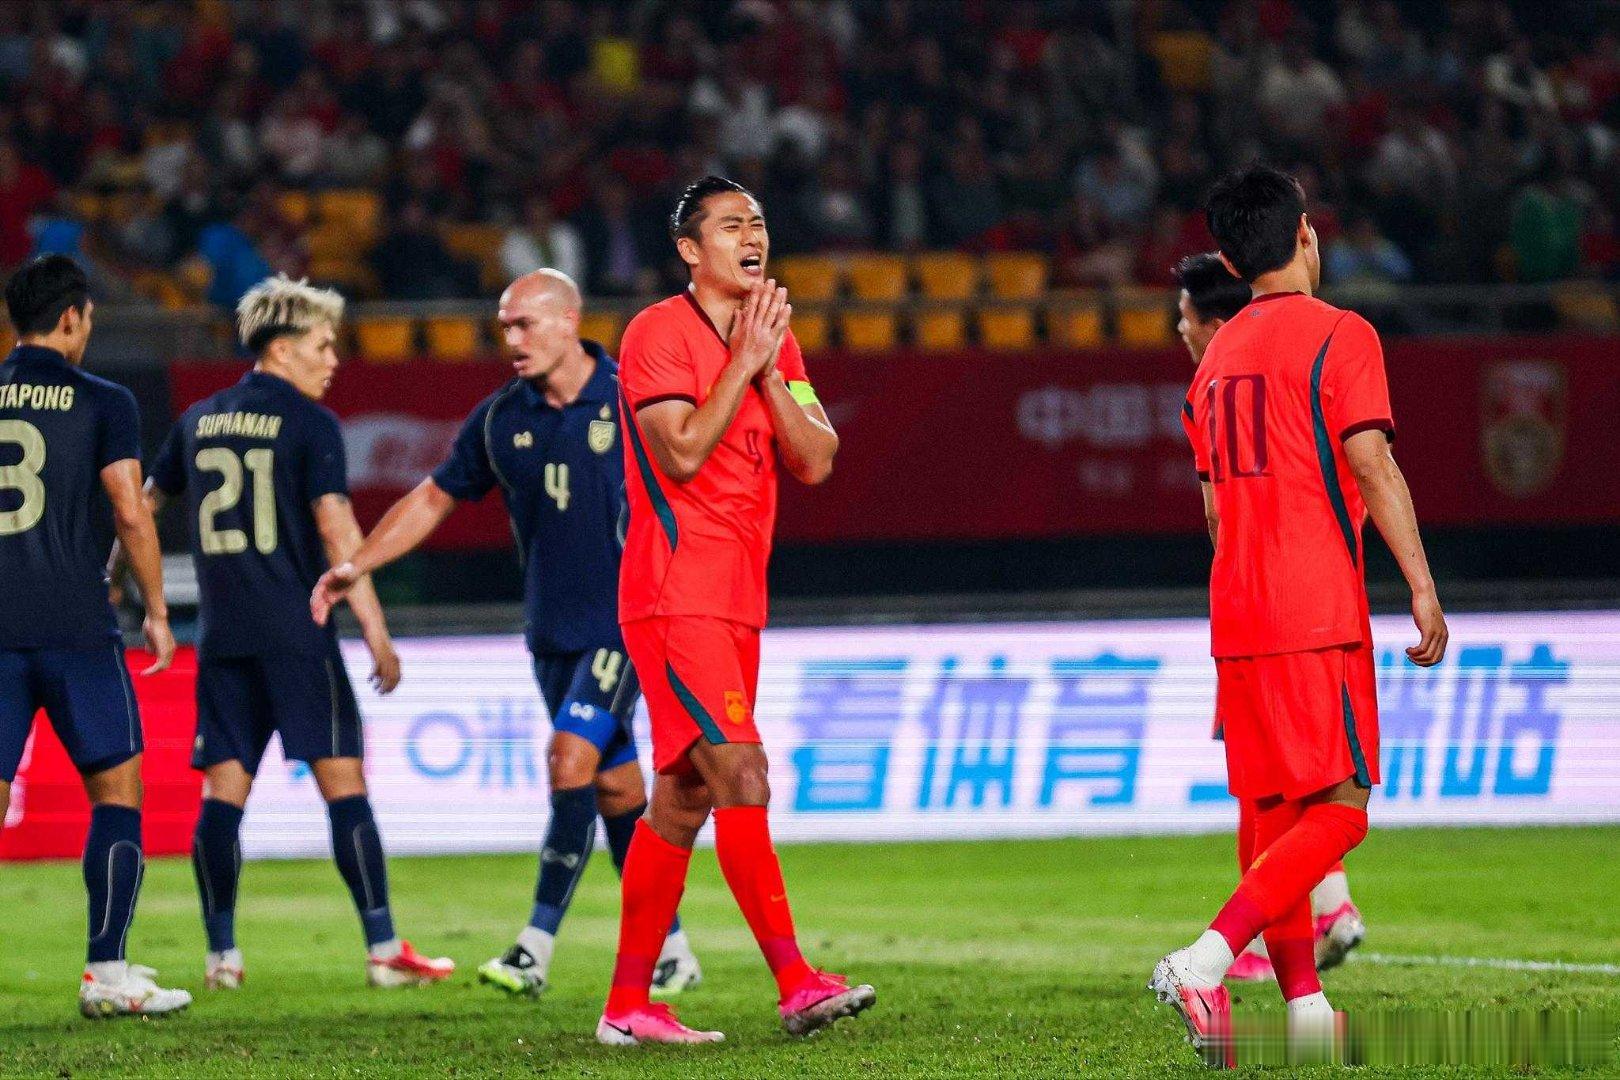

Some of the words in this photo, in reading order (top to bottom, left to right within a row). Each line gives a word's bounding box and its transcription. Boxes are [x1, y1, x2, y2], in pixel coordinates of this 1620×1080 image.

[1206, 373, 1275, 484] 10
[195, 447, 278, 555] 21
[544, 462, 571, 511] 4
[591, 647, 622, 693] 4
[790, 655, 1162, 811] 看体育
